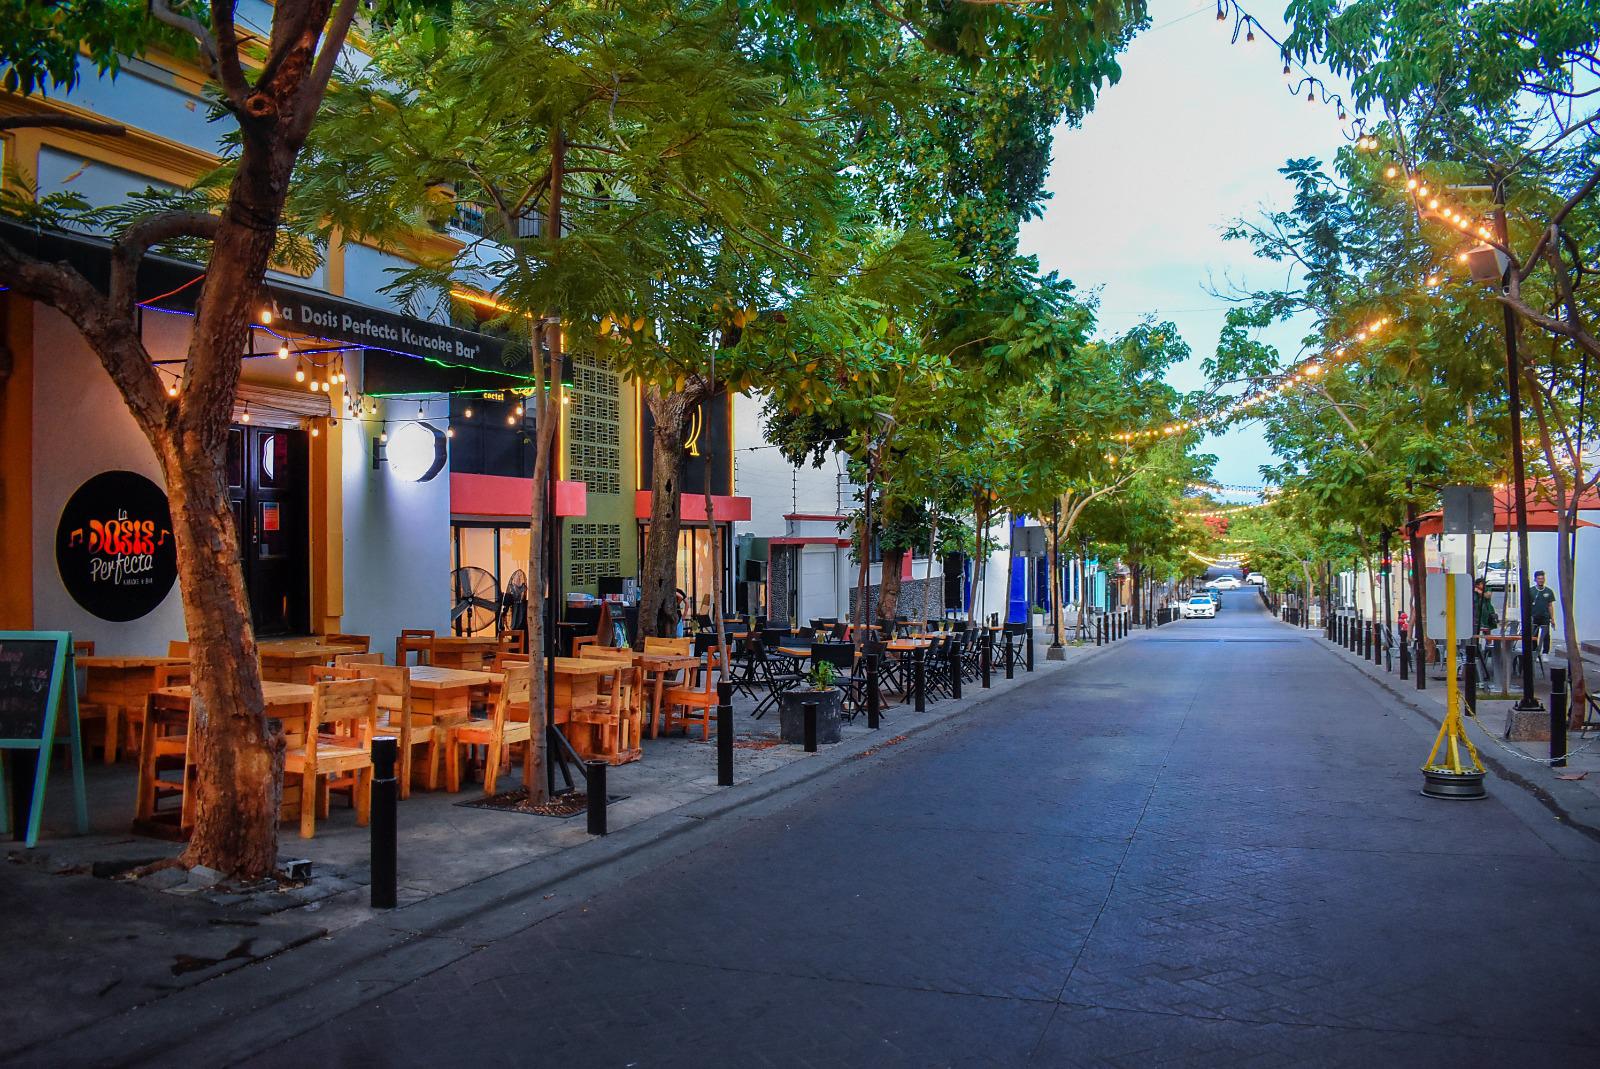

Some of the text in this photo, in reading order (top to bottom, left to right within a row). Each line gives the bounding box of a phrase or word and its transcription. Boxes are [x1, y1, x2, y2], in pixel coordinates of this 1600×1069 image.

[301, 306, 338, 328] Dosis
[342, 314, 398, 341] Perfecta
[401, 327, 453, 353] Karaoke
[118, 508, 129, 521] La
[88, 519, 155, 555] DOSIS
[89, 552, 154, 585] Perfecta
